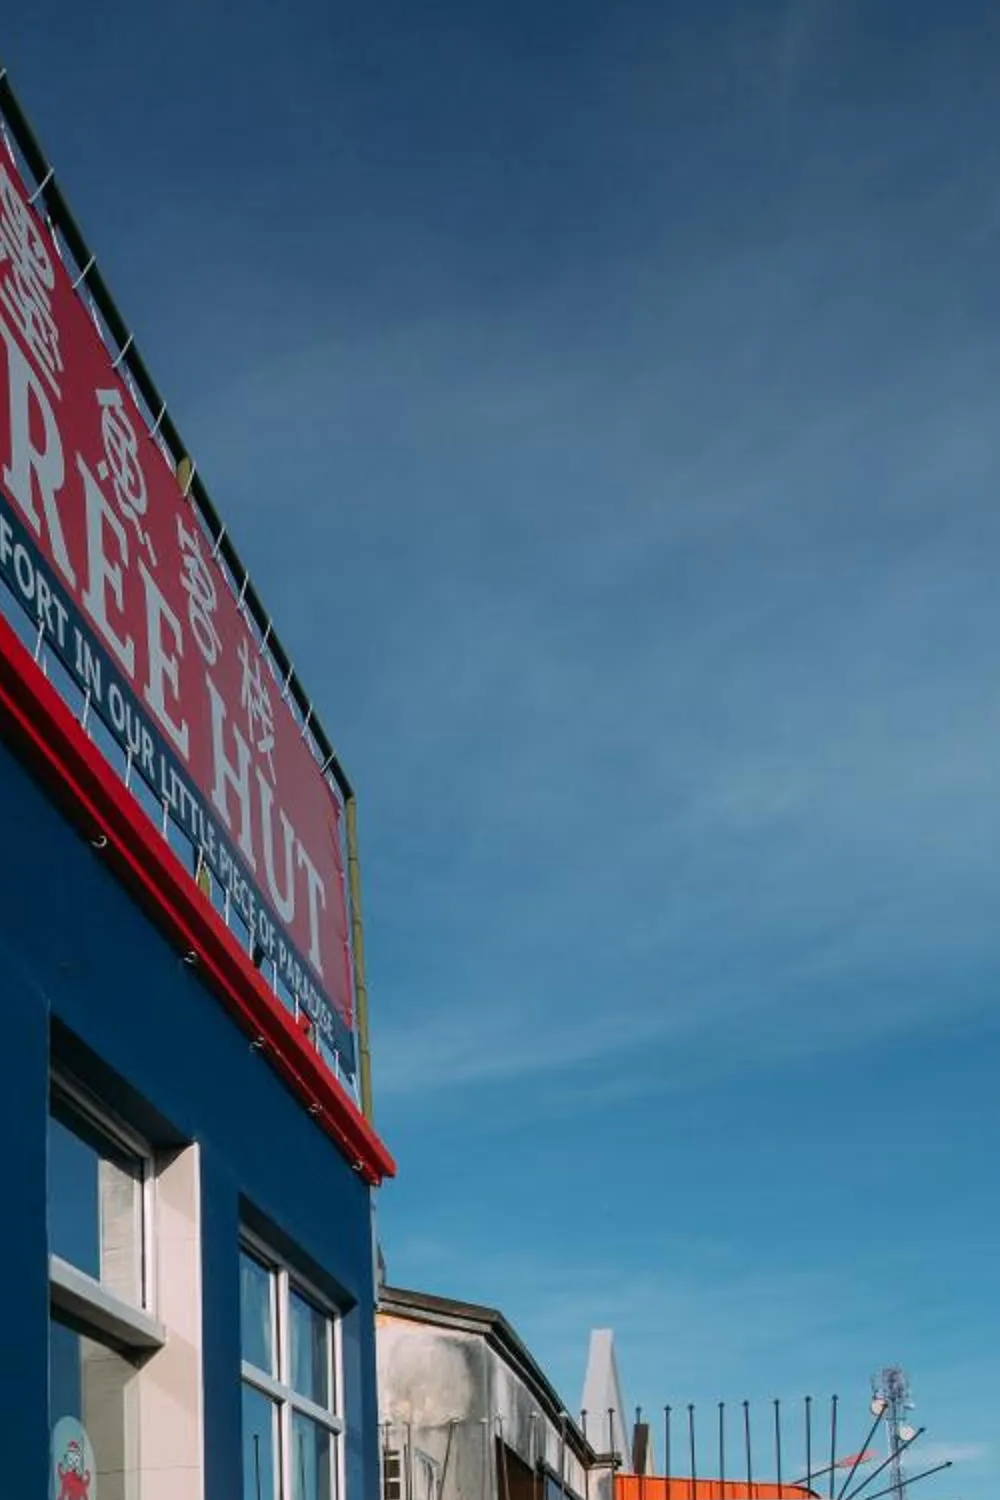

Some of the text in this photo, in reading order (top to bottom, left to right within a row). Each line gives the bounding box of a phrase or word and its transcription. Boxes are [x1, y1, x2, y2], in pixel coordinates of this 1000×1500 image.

[74, 628, 102, 702] IN
[108, 684, 155, 780] OUR
[160, 753, 217, 865] LITTLE
[219, 844, 257, 931] PIECE
[258, 909, 276, 954] OF
[205, 671, 328, 979] HUT
